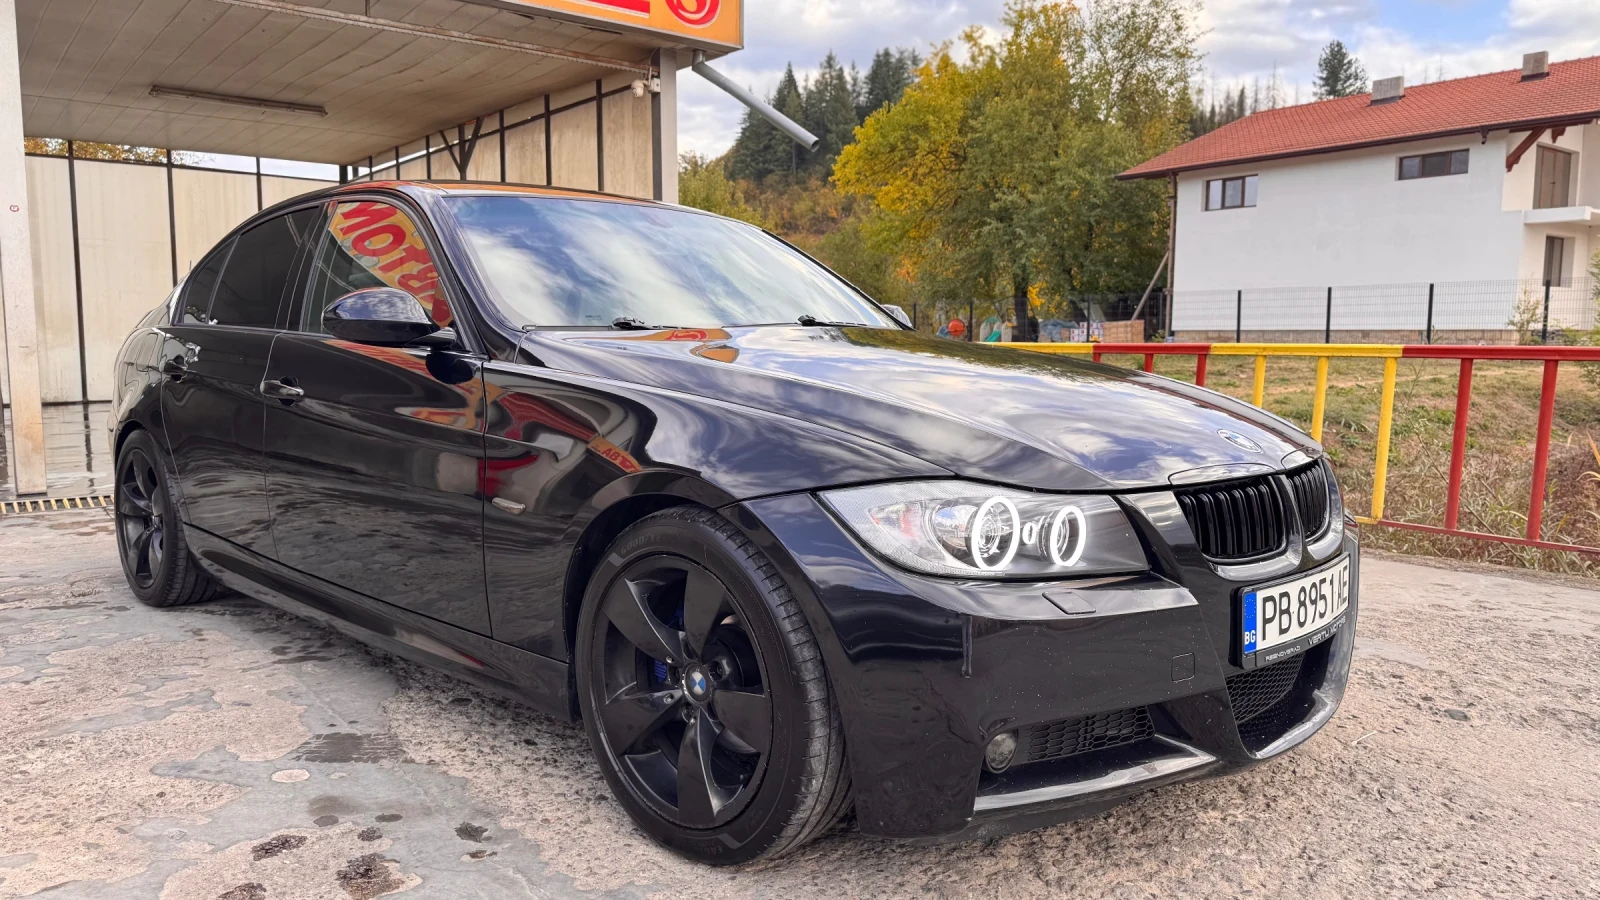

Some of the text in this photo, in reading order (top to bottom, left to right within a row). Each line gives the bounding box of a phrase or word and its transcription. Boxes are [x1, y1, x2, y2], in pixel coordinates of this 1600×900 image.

[1262, 564, 1348, 641] PB 8951 AE
[1244, 630, 1256, 645] BG
[1308, 628, 1330, 645] VERTU
